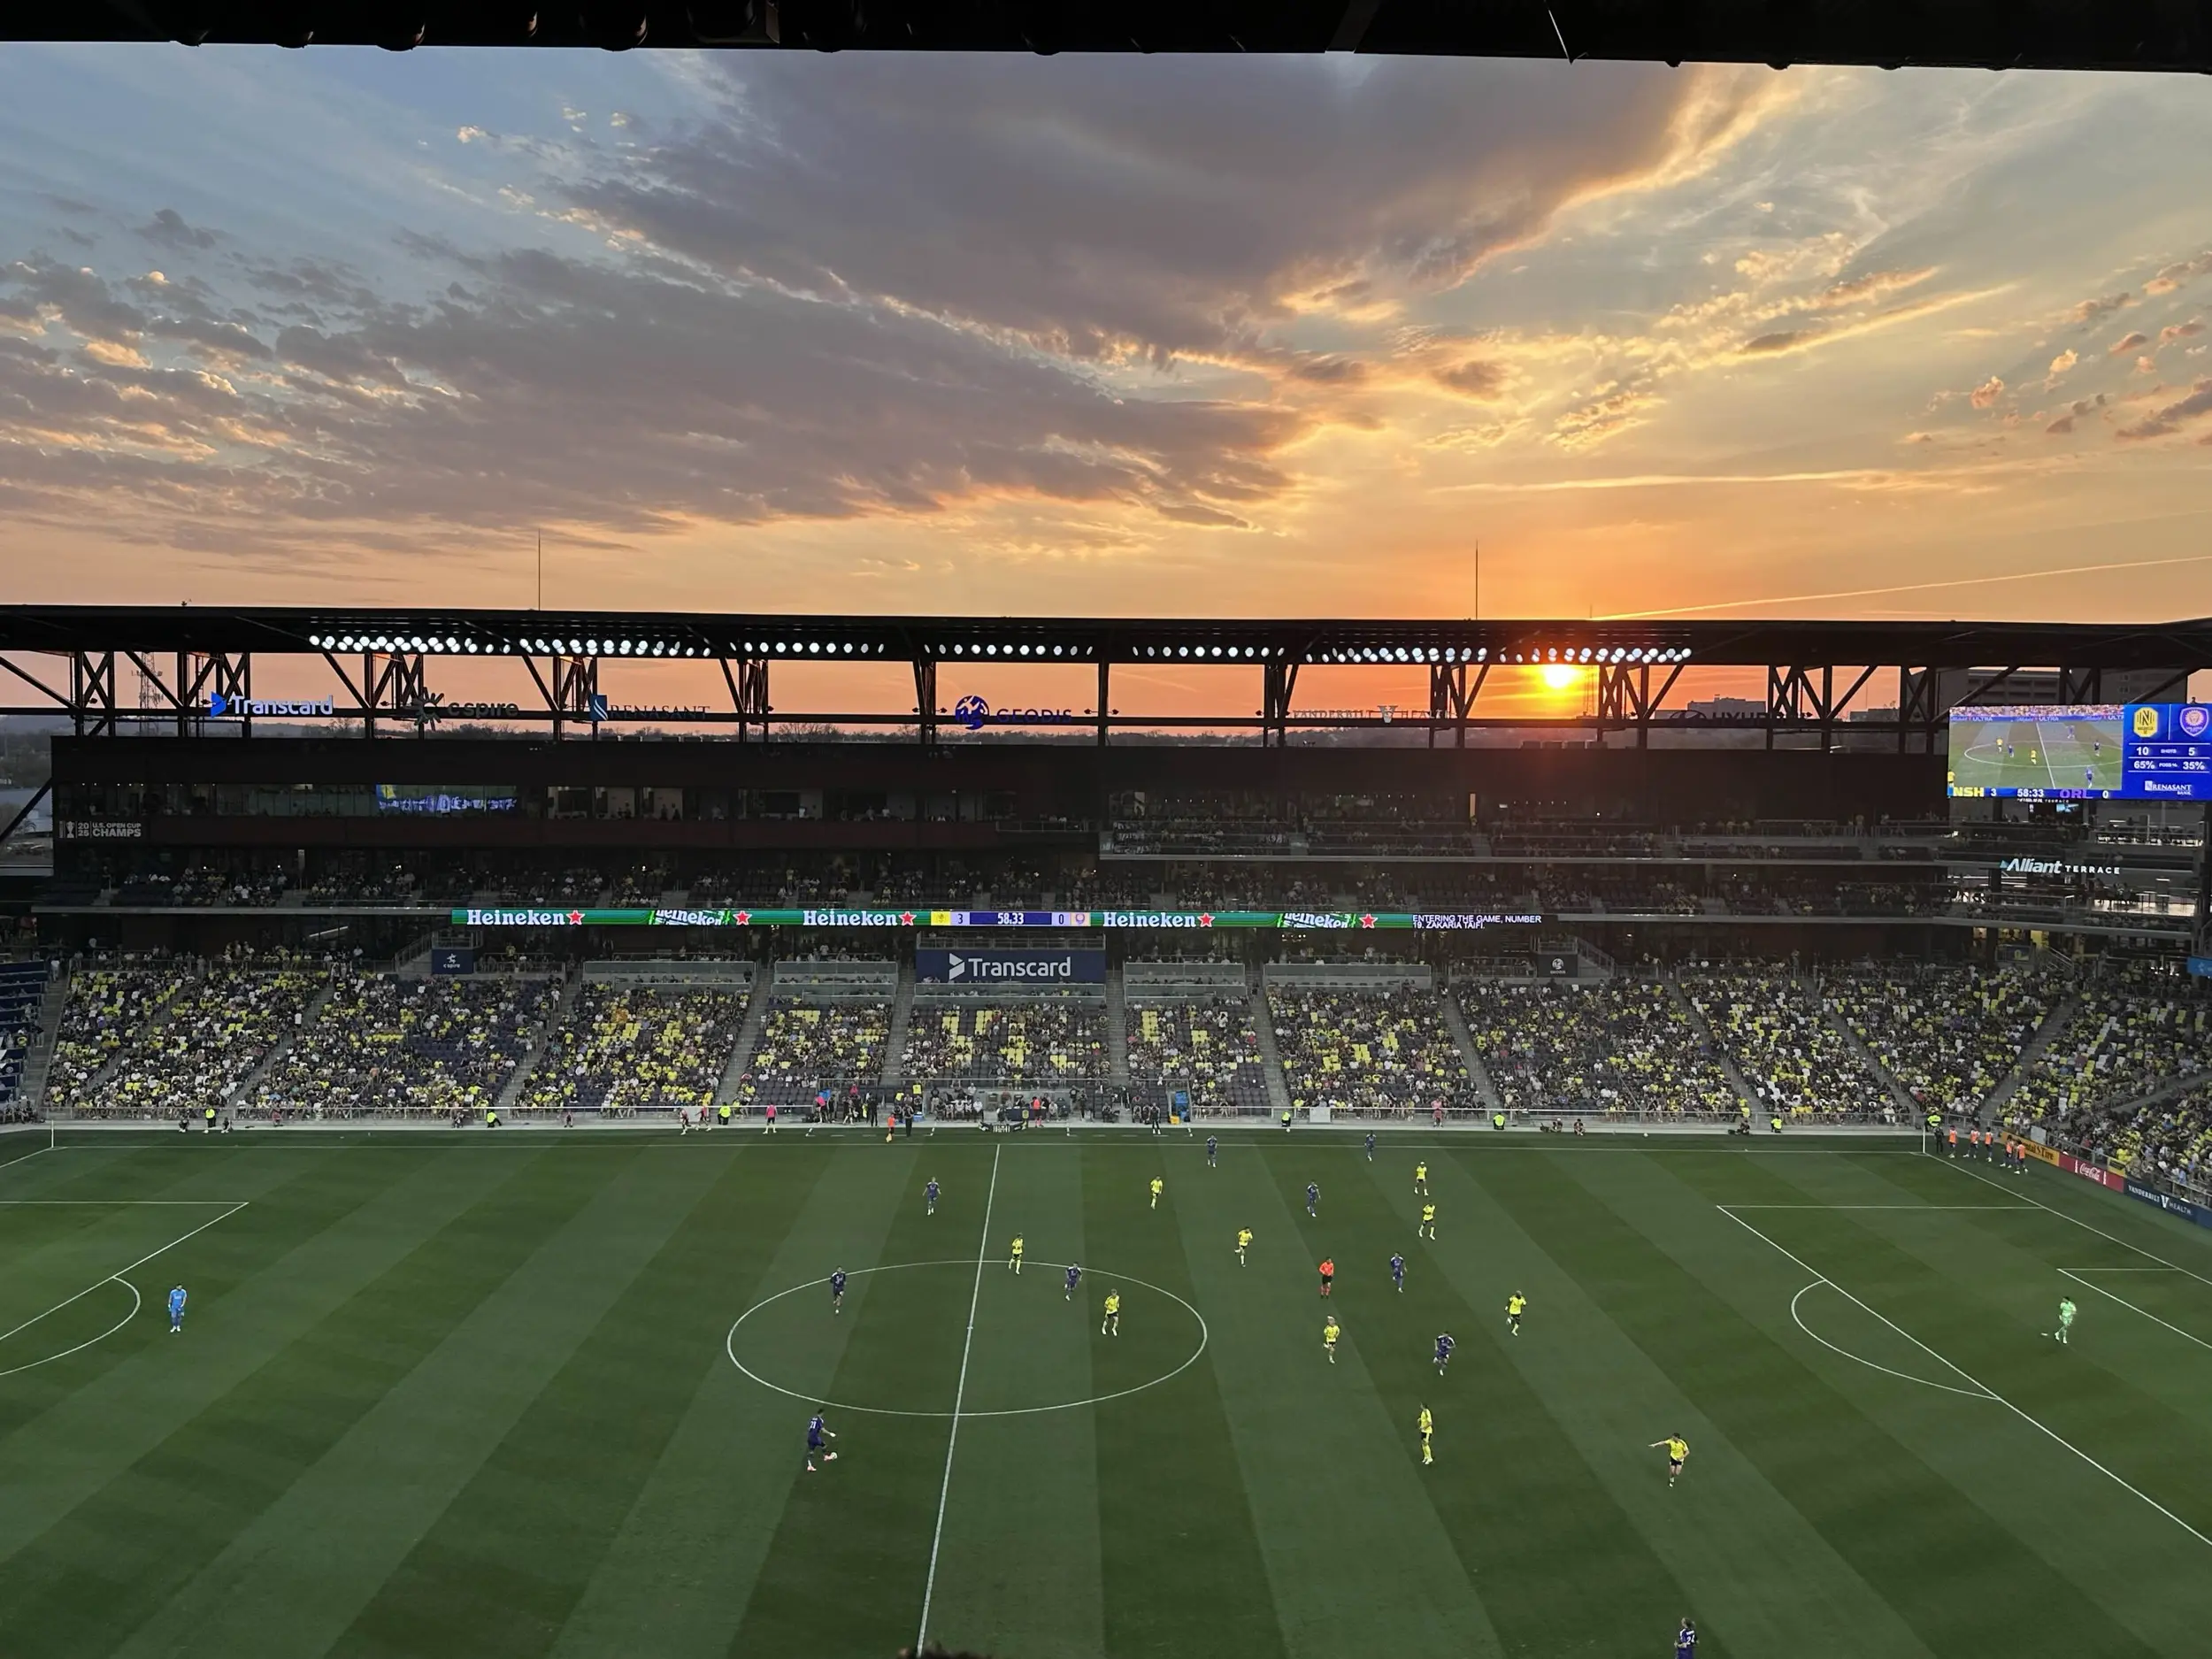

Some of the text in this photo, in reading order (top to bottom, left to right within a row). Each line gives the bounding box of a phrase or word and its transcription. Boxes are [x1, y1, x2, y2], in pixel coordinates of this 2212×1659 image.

[229, 695, 334, 715] Transcard
[610, 704, 710, 720] RENASANT
[996, 709, 1072, 723] GEODIS
[2136, 746, 2149, 756] 10
[2188, 747, 2196, 757] 5
[2133, 760, 2155, 770] 65%
[2182, 761, 2205, 771] 35%
[1953, 786, 2109, 799] NSH 3 58:33 ORL 0
[2151, 783, 2193, 792] RENASANT
[92, 828, 142, 837] CHAMPS
[2006, 858, 2121, 874] Alliant TERRACE
[466, 910, 565, 926] Heineken
[803, 910, 898, 926] Heineken
[957, 913, 964, 925] 3
[1058, 913, 1064, 925] 0
[1102, 911, 1196, 927] Heineken
[1412, 914, 1542, 924] ENTERING THE GAME, NUMBER
[968, 956, 1071, 978] Transcard
[2128, 1185, 2161, 1202] VANDERBILT
